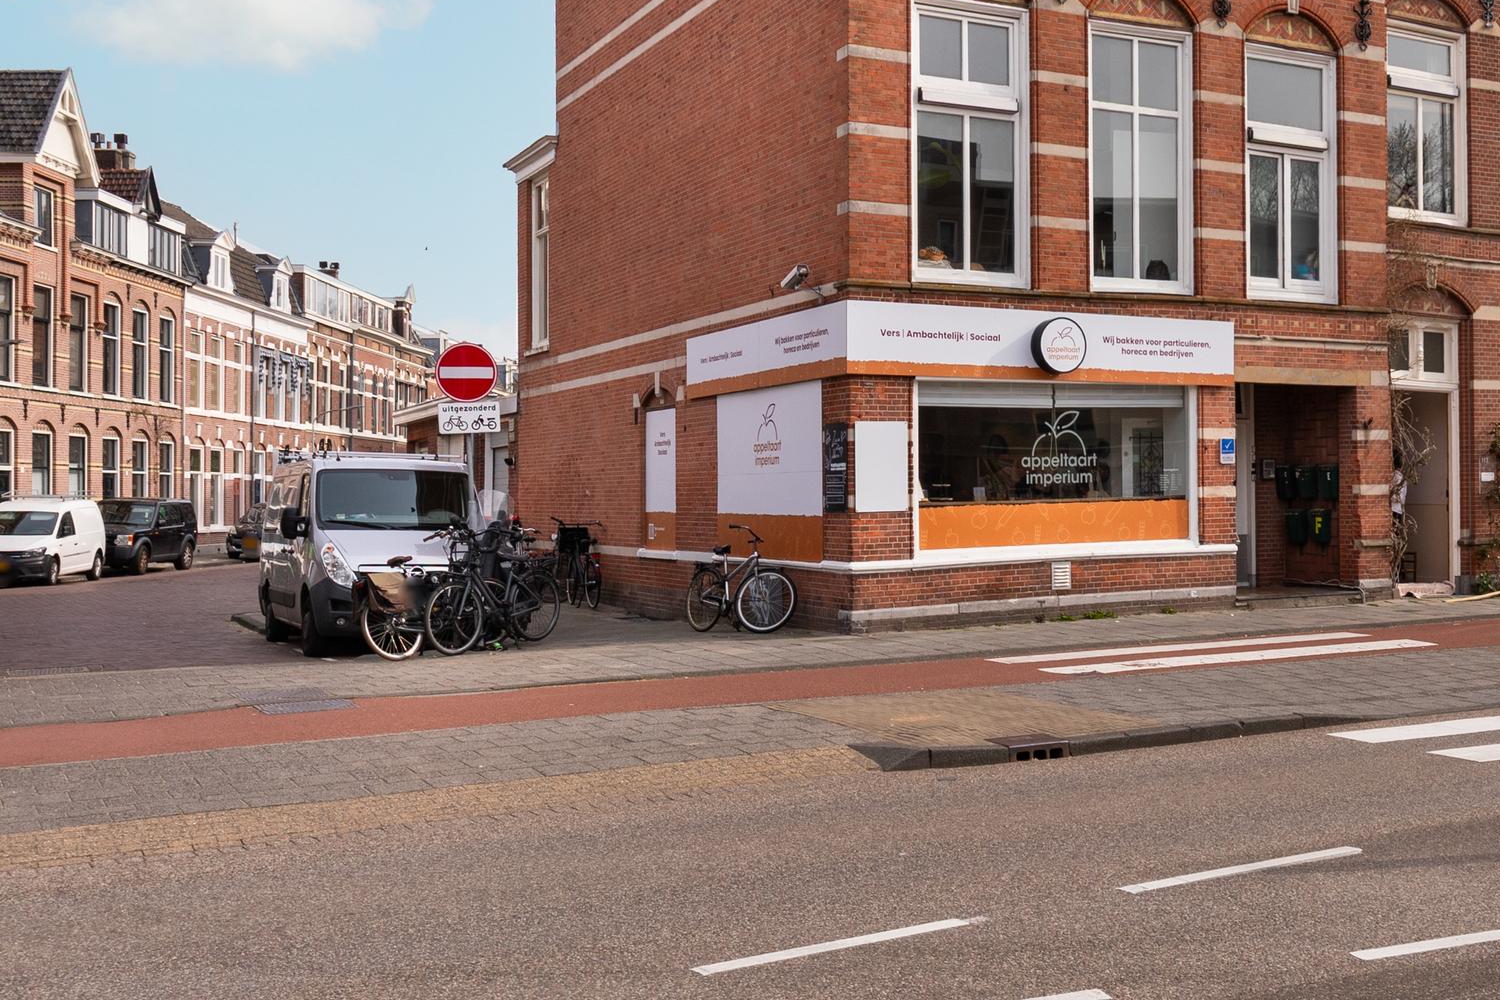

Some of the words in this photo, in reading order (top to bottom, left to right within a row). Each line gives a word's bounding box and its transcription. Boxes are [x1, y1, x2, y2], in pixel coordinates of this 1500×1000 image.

[880, 329, 900, 337] Vers
[906, 330, 964, 342] Ambachtelijk
[970, 333, 1001, 342] Sociaal
[1102, 336, 1115, 346] Wij
[1116, 336, 1144, 346] bakken
[1145, 338, 1162, 346] voor
[1163, 338, 1212, 349] particulieren,
[1046, 346, 1081, 355] appeltaart
[1121, 347, 1148, 356] horeca
[1159, 348, 1194, 359] bedrijven
[1048, 354, 1079, 362] imperium
[442, 405, 496, 413] uitgezonderd
[753, 440, 781, 454] appeltaart
[755, 455, 780, 468] imperium
[1021, 453, 1098, 471] appeltaart
[1026, 470, 1093, 487] imperium
[1315, 517, 1323, 534] F
